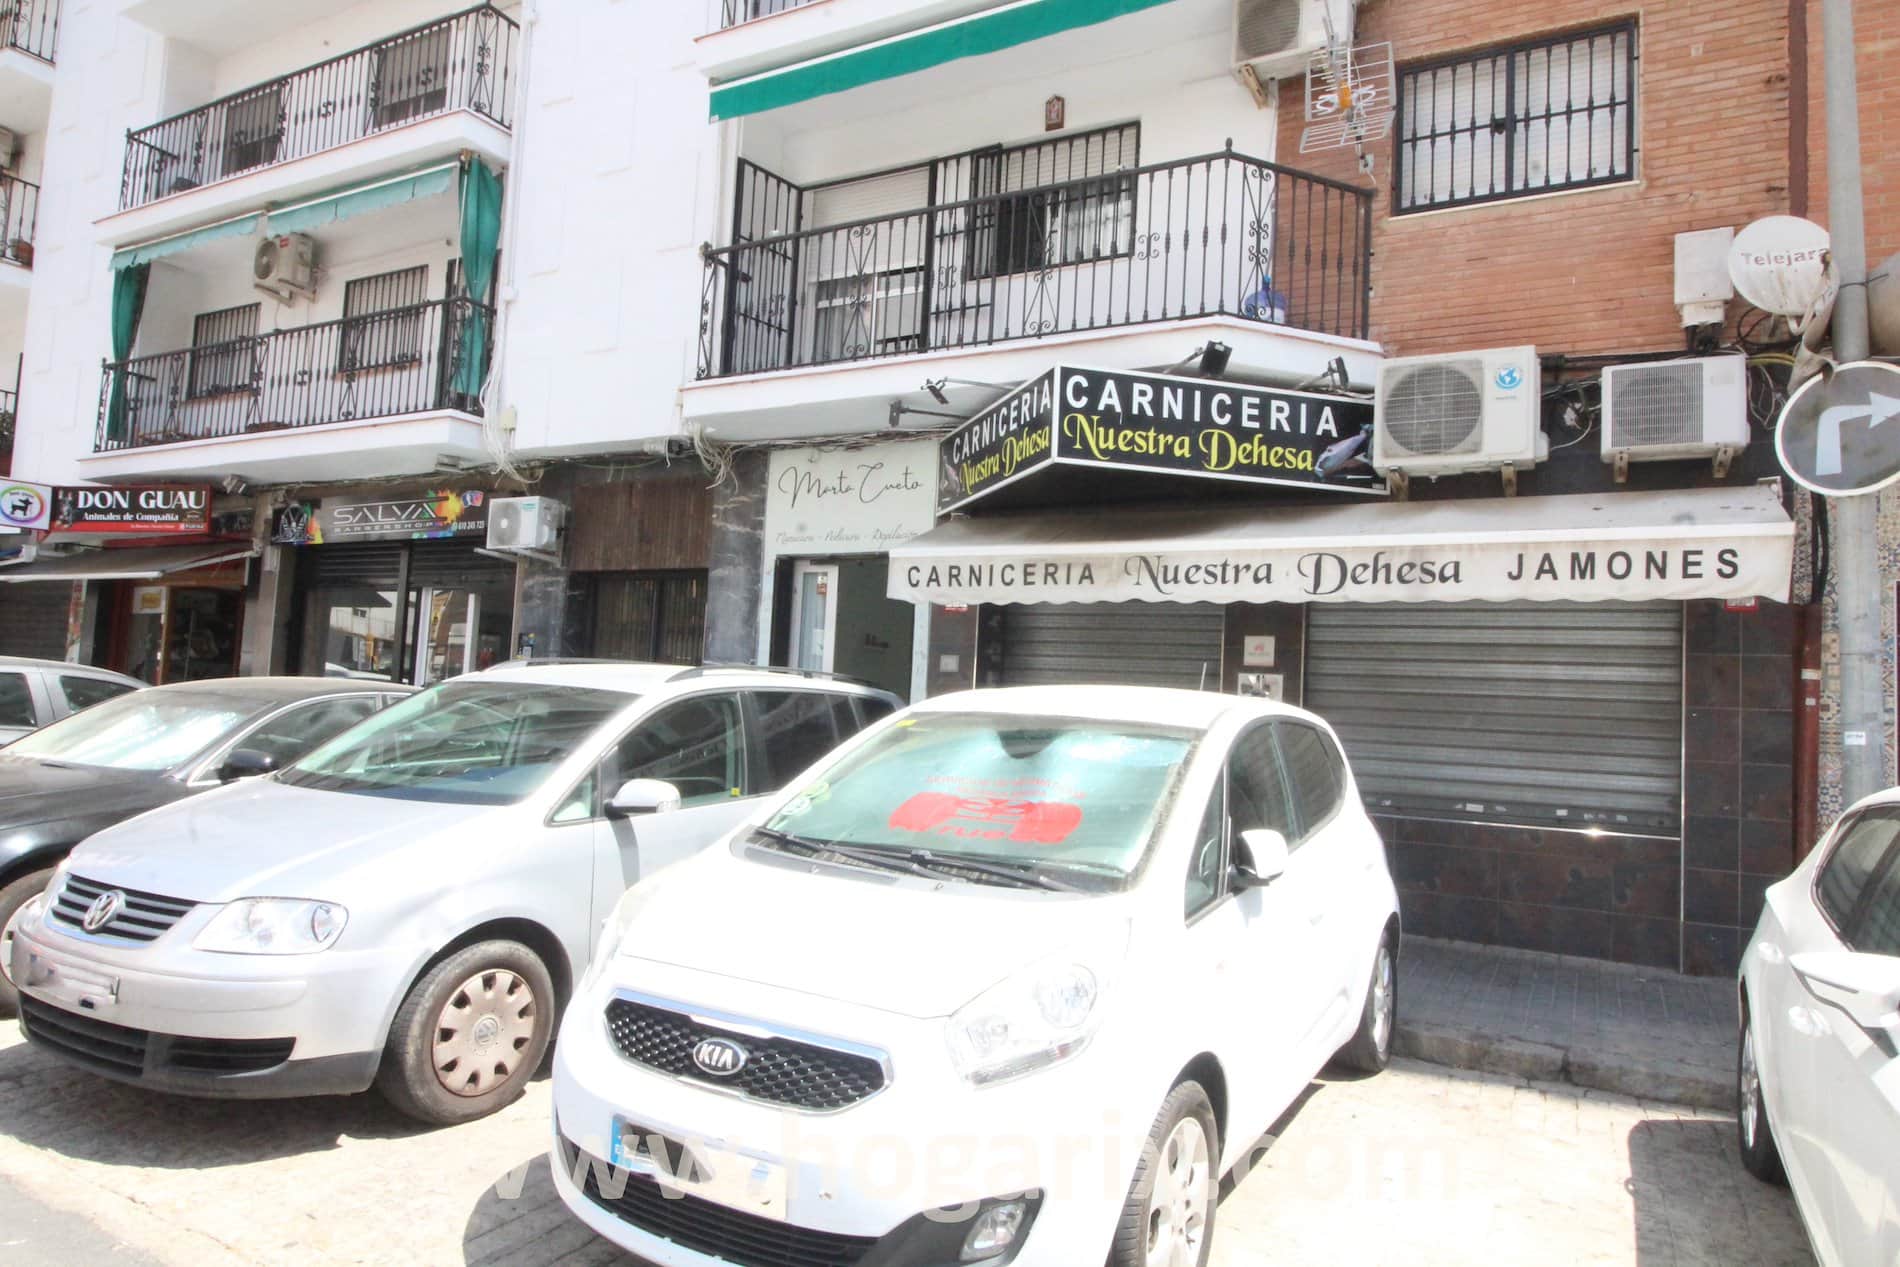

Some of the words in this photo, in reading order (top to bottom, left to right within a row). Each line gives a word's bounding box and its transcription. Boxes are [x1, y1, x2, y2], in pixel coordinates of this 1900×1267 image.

[952, 378, 1052, 462] CARNICERIA
[1066, 375, 1338, 438] CARNICERIA
[960, 455, 1000, 495] Nuestra
[1001, 424, 1051, 478] Dehesa
[1063, 413, 1192, 461] Nuestra
[1200, 428, 1314, 471] Dehesa
[78, 490, 130, 509] DON
[139, 490, 206, 509] GUAU
[778, 466, 855, 509] Marta
[82, 511, 121, 521] Animales
[123, 511, 134, 521] de
[333, 502, 436, 525] SALVA
[908, 562, 1095, 588] CARNICERIA
[1124, 554, 1273, 594] Nuestra
[1297, 552, 1463, 596] Dehesa
[1507, 549, 1740, 582] JAMONES
[698, 1043, 733, 1070] KIA
